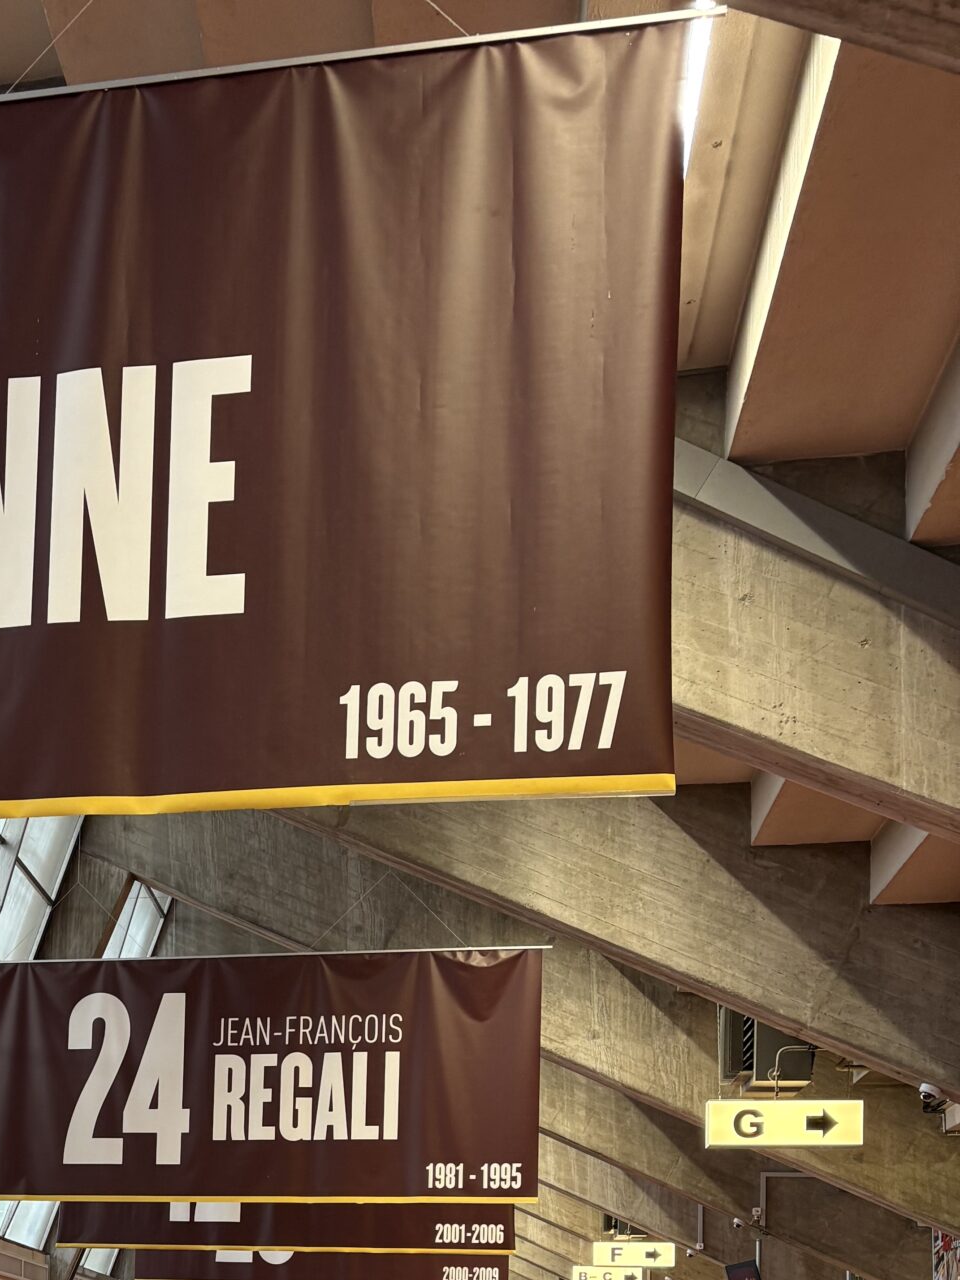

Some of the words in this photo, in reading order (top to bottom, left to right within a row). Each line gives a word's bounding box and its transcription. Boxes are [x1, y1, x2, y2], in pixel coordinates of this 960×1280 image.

[340, 680, 459, 760] 1965
[507, 671, 627, 753] 1977
[213, 1013, 403, 1050] JEAN-FRANÇOIS
[63, 992, 190, 1165] 24
[212, 1051, 401, 1141] REGALI
[734, 1109, 764, 1138] G
[426, 1163, 464, 1189] 1981
[481, 1163, 522, 1189] 1995
[435, 1224, 505, 1244] 2001-2006
[611, 1248, 623, 1262] F
[579, 1272, 588, 1280] B
[603, 1272, 612, 1280] C
